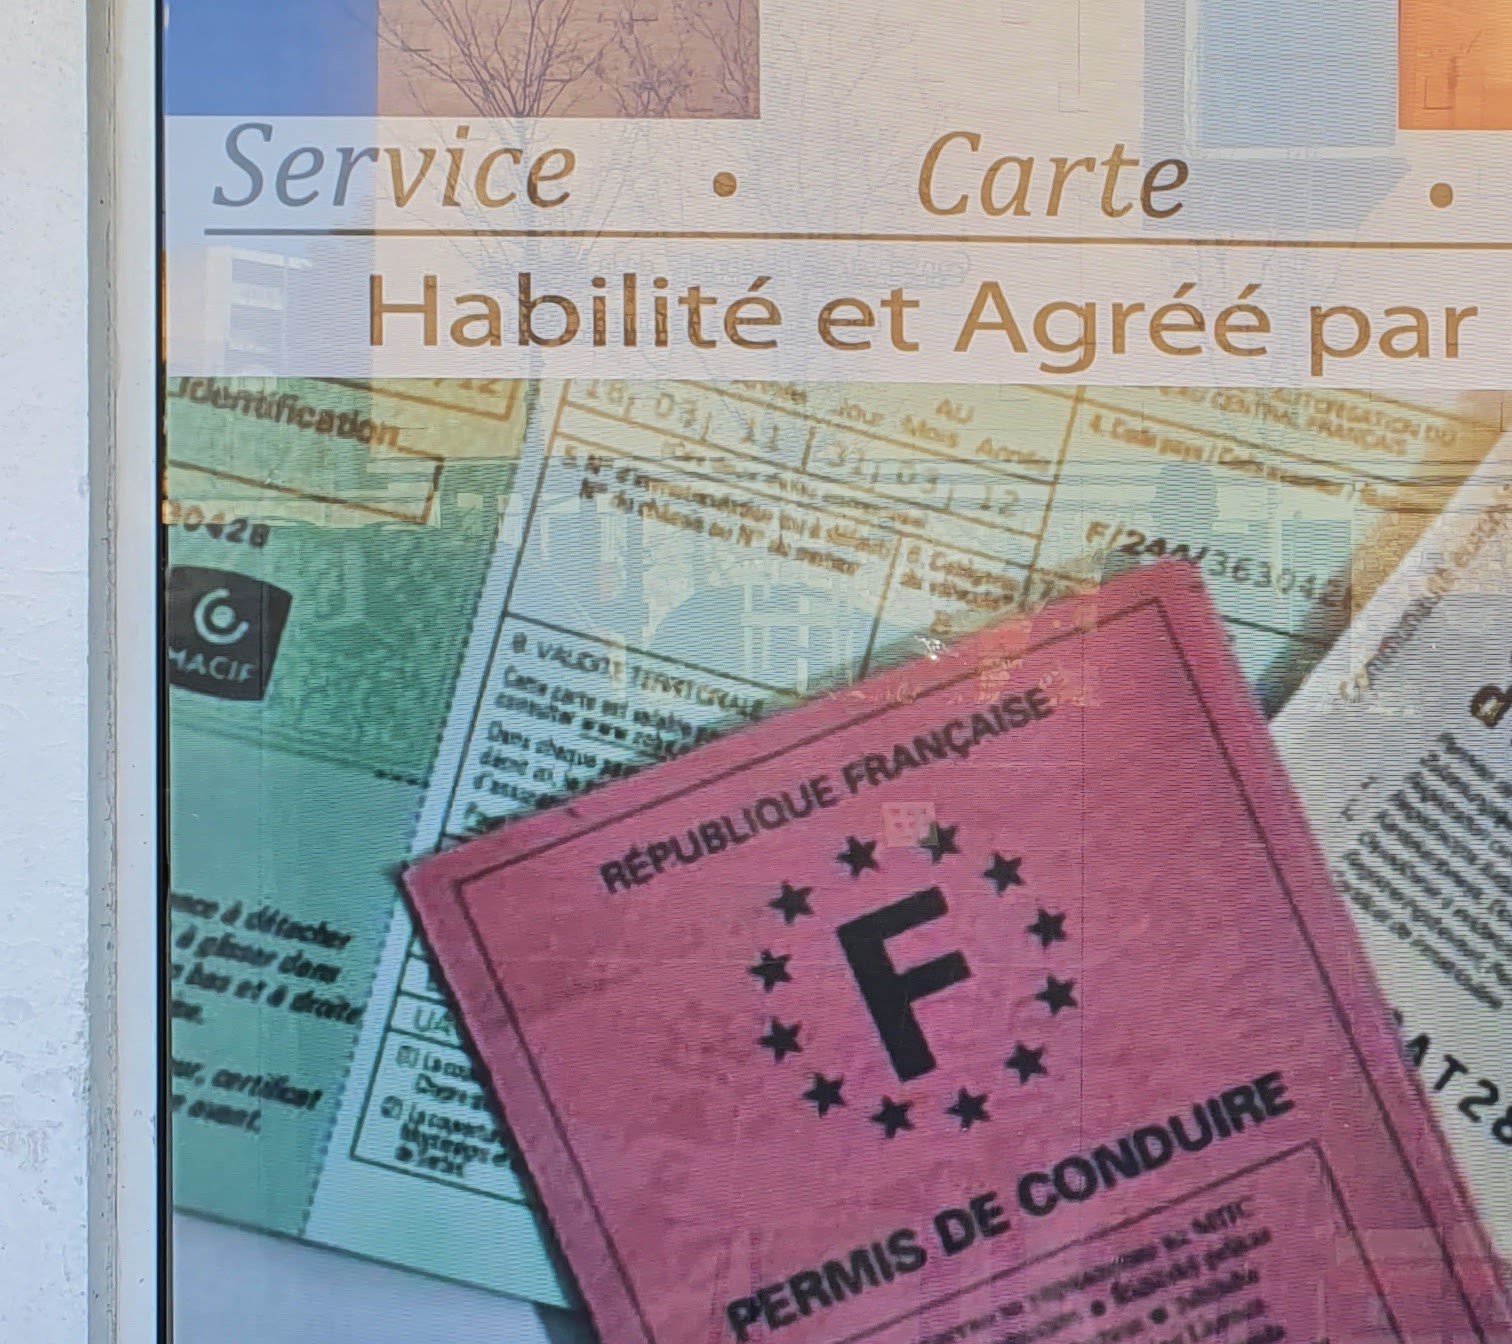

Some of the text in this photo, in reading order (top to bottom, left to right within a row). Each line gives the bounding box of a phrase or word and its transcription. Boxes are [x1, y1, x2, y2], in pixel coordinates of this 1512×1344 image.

[212, 120, 578, 208] Service
[918, 130, 1190, 218] Carte
[370, 266, 780, 356] Habilité
[816, 286, 916, 354] et
[950, 281, 1272, 381] Agréé
[1308, 296, 1482, 382] par
[602, 684, 1060, 898] RÉPUBLIQUE FRANÇAISE
[836, 886, 972, 1083] F
[726, 1228, 930, 1344] PERMIS
[934, 1192, 1012, 1256] DE
[1016, 1072, 1294, 1218] CONDUIRE
